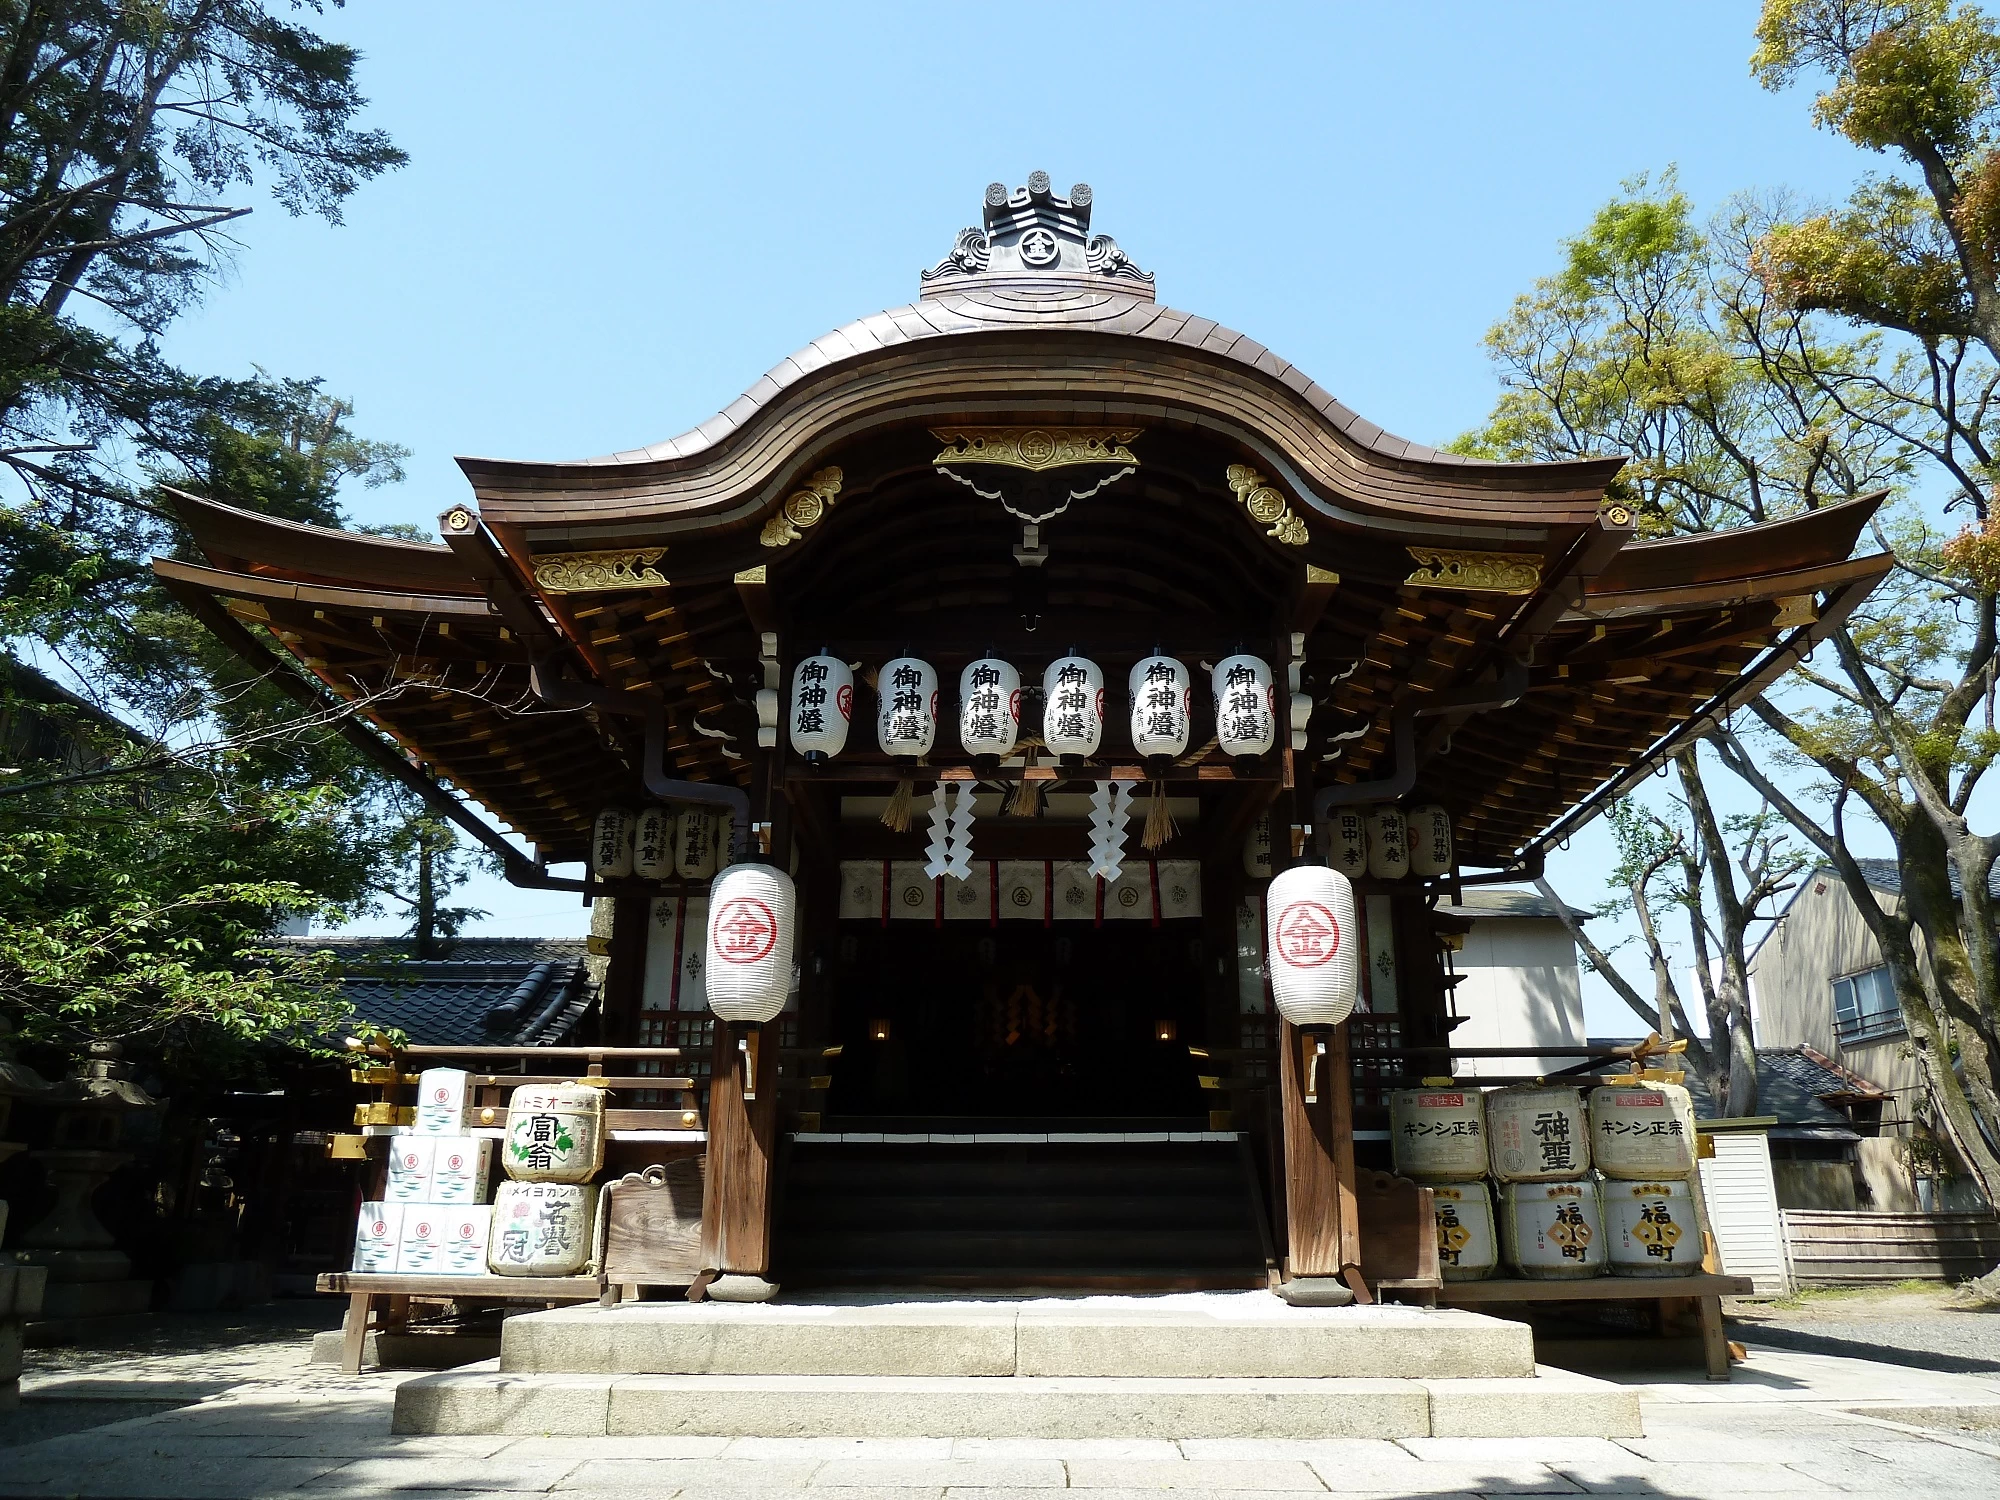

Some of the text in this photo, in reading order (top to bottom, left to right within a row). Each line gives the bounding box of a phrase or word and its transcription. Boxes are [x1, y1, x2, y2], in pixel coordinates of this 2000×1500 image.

[1022, 231, 1055, 258] 金
[797, 661, 828, 733] 御神燈
[892, 665, 922, 740] 御神燈
[970, 664, 1000, 739] 御神燈
[1057, 663, 1087, 738] 御神燈
[1145, 662, 1176, 737] 御神燈
[1226, 664, 1260, 739] 御神燈
[1256, 817, 1271, 865] 村井明
[1341, 815, 1358, 866] 田中孝
[905, 888, 922, 905] 金
[1013, 888, 1030, 905] 金
[1120, 888, 1137, 905] 金
[719, 903, 770, 954] 金
[1281, 906, 1333, 958] 金
[523, 1096, 573, 1109] トミオー
[1421, 1095, 1462, 1106] 京仕込
[1620, 1094, 1661, 1106] 京仕込
[526, 1113, 559, 1170] 富翁
[1403, 1119, 1480, 1137] キンシ正宗
[1531, 1110, 1576, 1172] 神聖
[1601, 1119, 1683, 1137] キンシ正宗
[512, 1187, 568, 1198] メイヨカン
[1556, 1201, 1588, 1263] 福小町
[1641, 1200, 1675, 1262] 福小町
